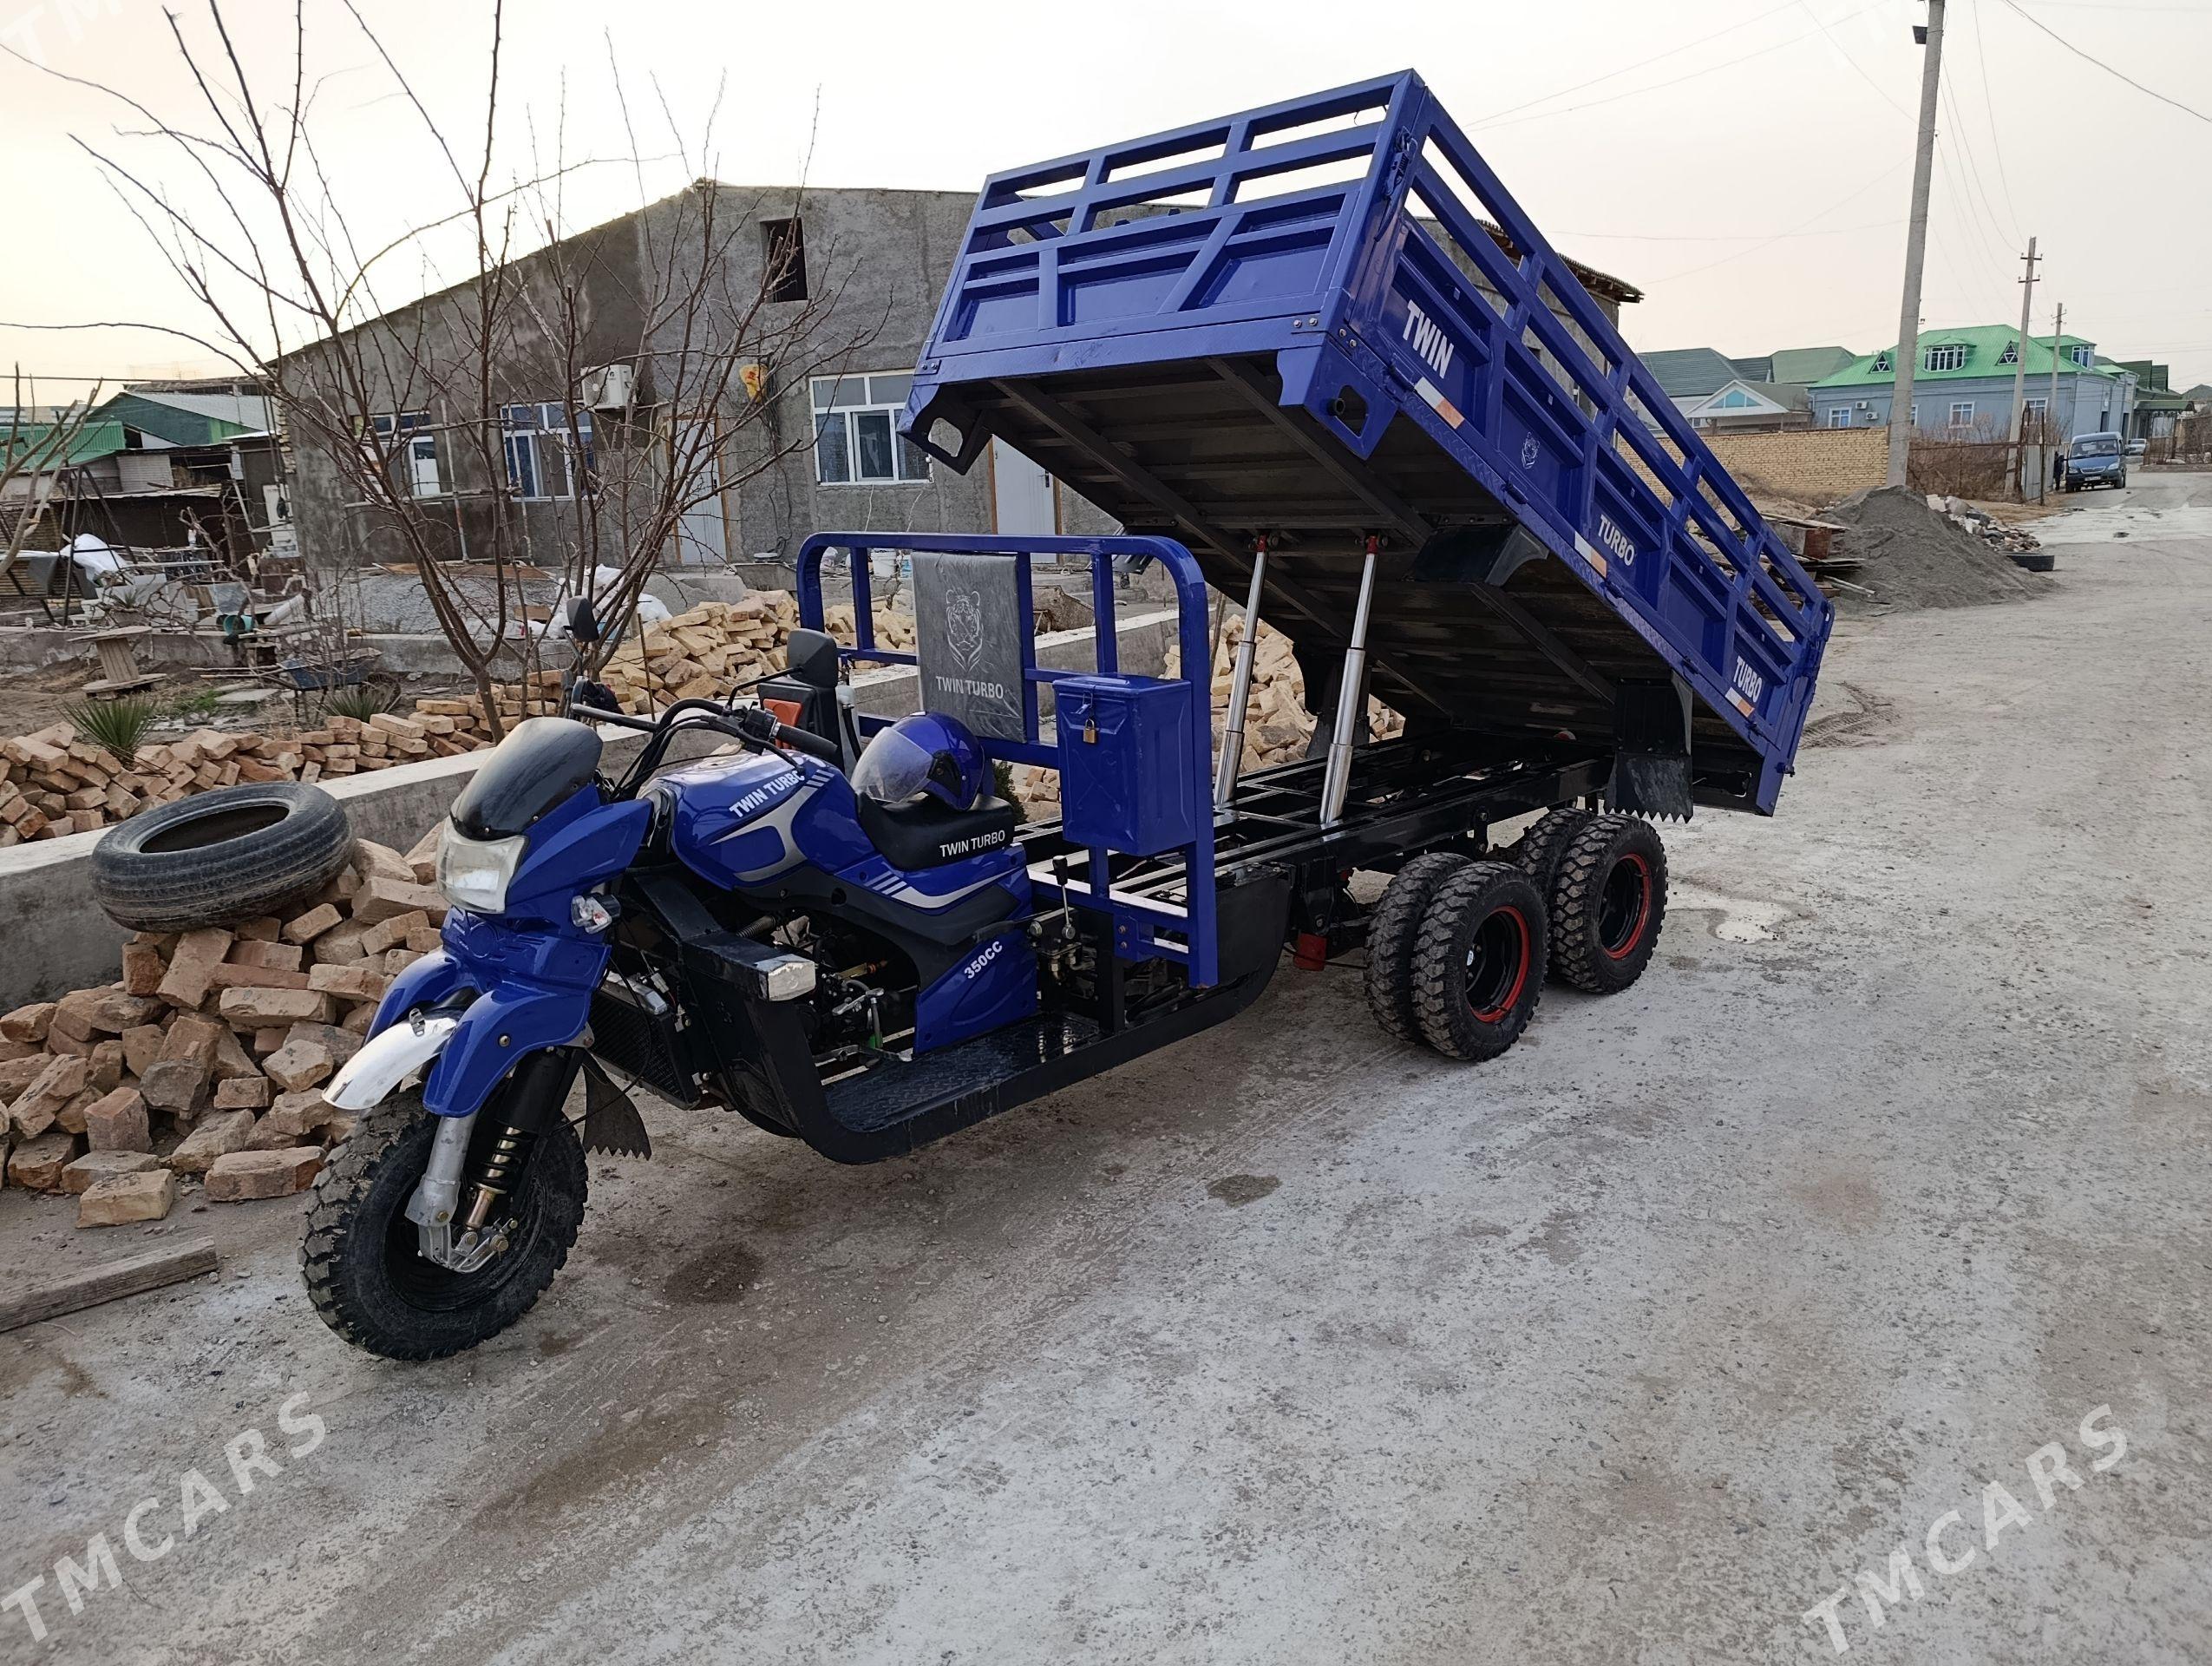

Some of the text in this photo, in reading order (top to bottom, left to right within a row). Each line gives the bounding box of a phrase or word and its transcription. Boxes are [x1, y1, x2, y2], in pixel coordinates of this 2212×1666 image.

[1402, 298, 1455, 380] TWIN
[1598, 514, 1635, 566] TURBO
[935, 675, 1004, 699] TWIN TURBO
[1733, 655, 1763, 703] TURBO
[729, 788, 769, 817] TWIN
[939, 830, 1005, 857] TWIN TURBO
[964, 941, 1003, 979] 350CC
